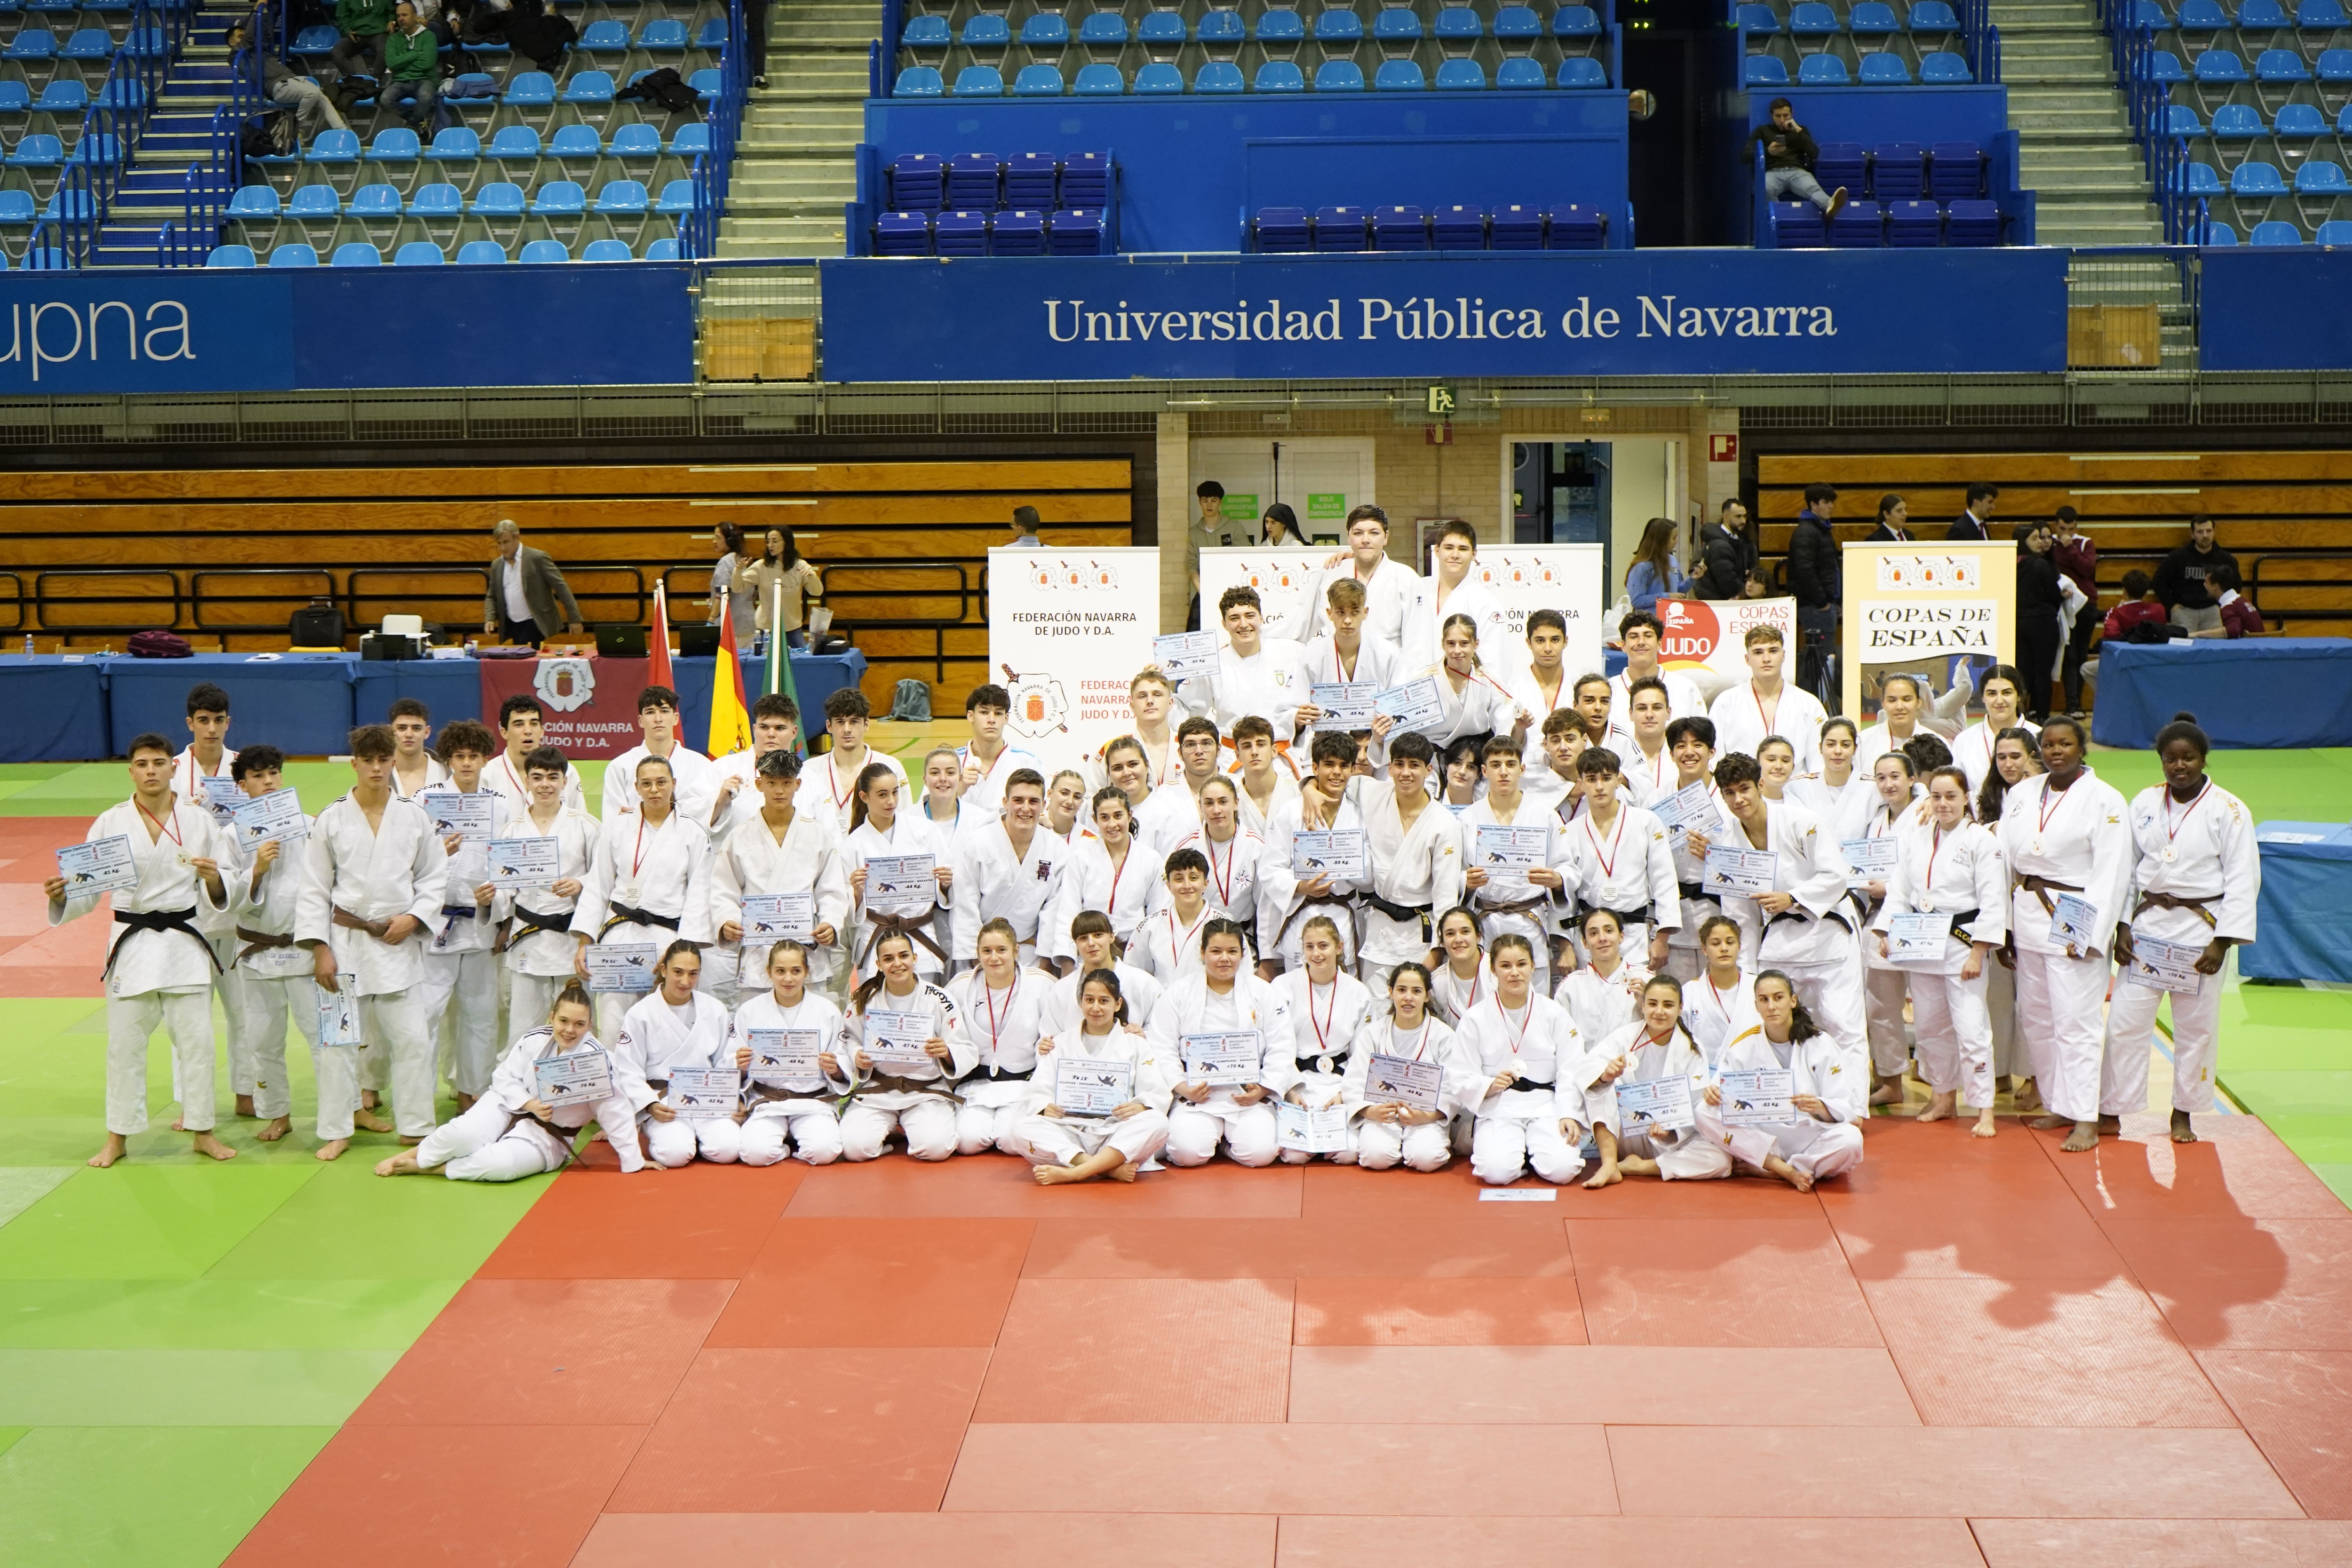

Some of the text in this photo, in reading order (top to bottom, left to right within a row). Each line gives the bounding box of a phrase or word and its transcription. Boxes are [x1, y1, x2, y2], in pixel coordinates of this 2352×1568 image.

[1044, 295, 1838, 342] Universidad Pública de Navarra
[1013, 611, 1136, 622] FEDERACIÓN NAVARRA
[1740, 606, 1788, 619] COPAS
[1868, 608, 1991, 623] COPAS DE
[1035, 627, 1113, 637] DE JUDO Y D.A.
[1509, 624, 1522, 632] DO
[1869, 626, 1990, 647] ESPAÑA
[1659, 638, 1711, 655] JUDO
[1022, 685, 1043, 693] NAVARRA
[1081, 681, 1132, 689] FEDERACI
[1081, 710, 1108, 720] JUDO
[1112, 710, 1119, 719] Y
[576, 723, 634, 732] NAVARRA
[575, 738, 583, 747] Y
[586, 738, 610, 748] D.A.
[925, 985, 954, 1012] TAGOYA
